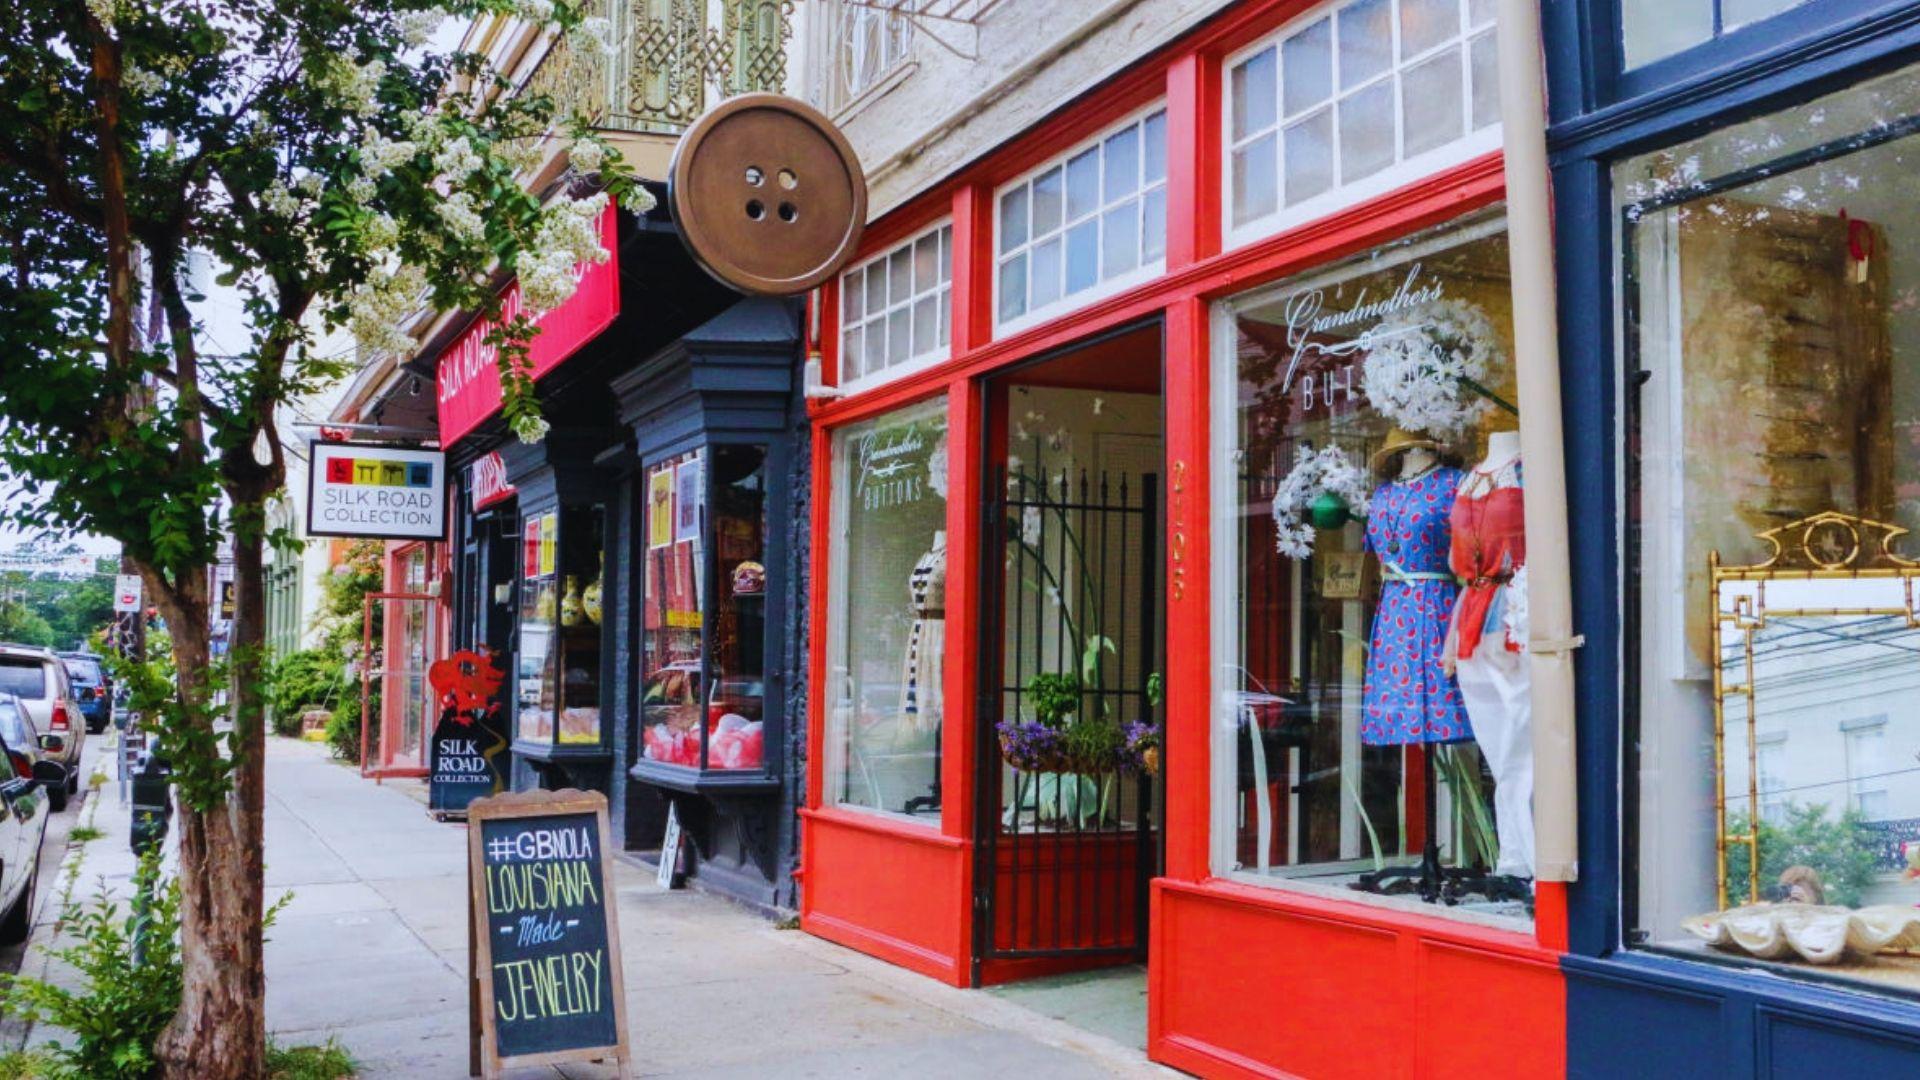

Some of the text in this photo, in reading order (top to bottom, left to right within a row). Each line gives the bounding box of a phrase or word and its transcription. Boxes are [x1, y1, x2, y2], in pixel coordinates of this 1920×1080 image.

[1283, 262, 1446, 394] Grandmother's
[438, 343, 463, 404] SILK
[324, 488, 433, 509] SILK ROAD
[864, 475, 922, 511] BUTTONS
[324, 508, 433, 525] COLLECTION
[439, 738, 478, 756] SILK
[433, 774, 491, 784] COLLECTION
[438, 756, 486, 773] ROAD
[488, 827, 593, 861] #GBNOLA
[487, 860, 599, 914] LOUISIANA
[494, 949, 603, 1022] JEWELRY
